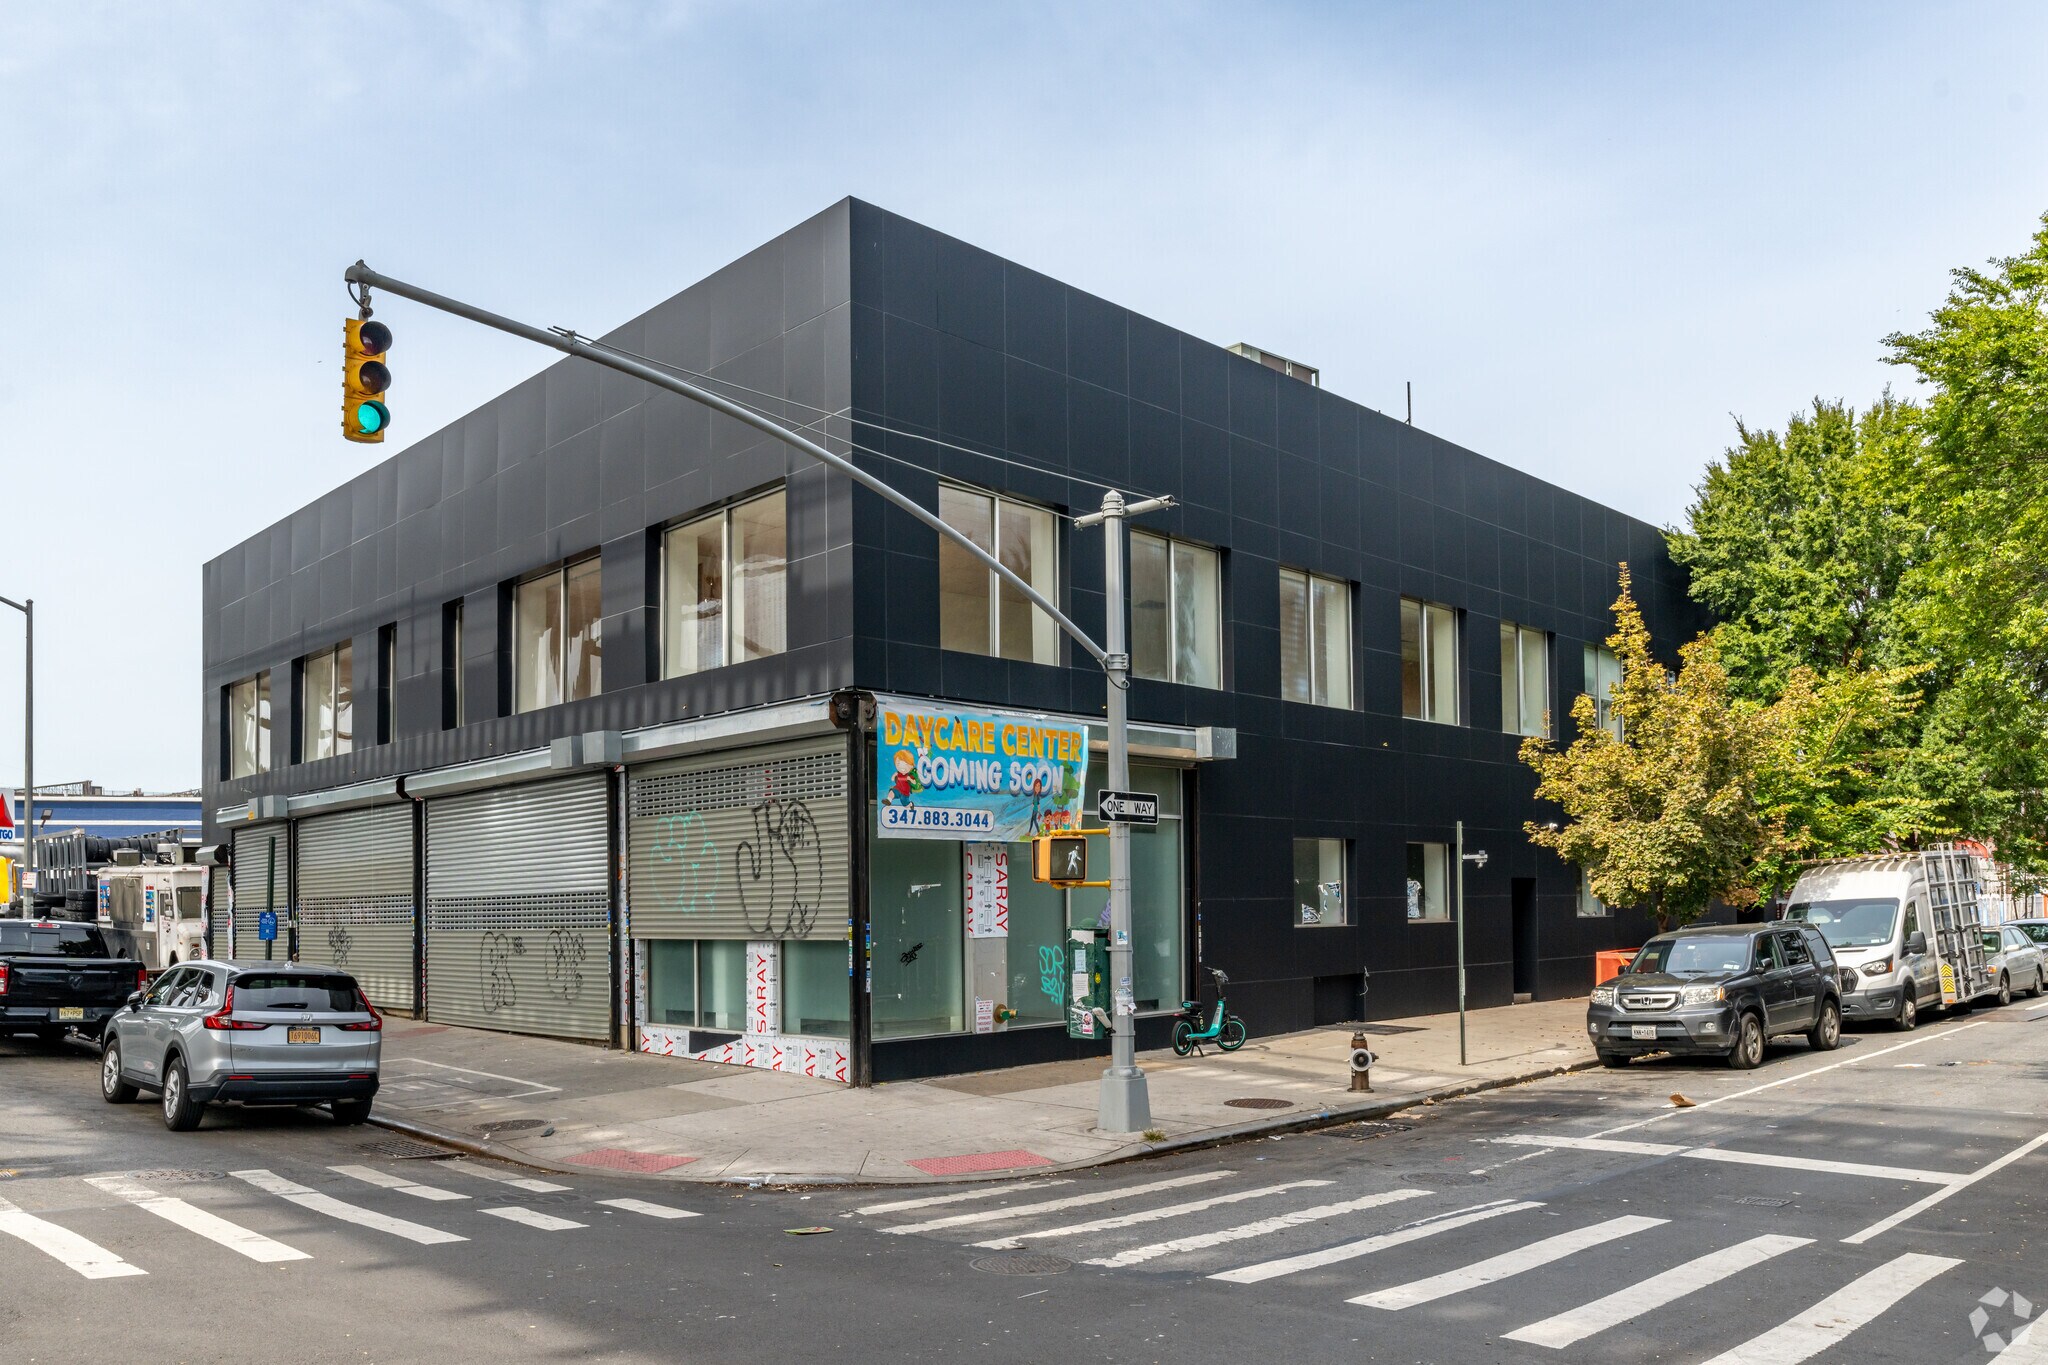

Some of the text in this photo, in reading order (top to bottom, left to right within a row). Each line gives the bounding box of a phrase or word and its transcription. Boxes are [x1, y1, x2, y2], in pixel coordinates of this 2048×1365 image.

[884, 711, 1082, 762] DAYCARE CENTER
[917, 755, 1065, 797] COMING SOON
[888, 808, 989, 828] 347.883.3044
[1107, 800, 1153, 815] ONE WAY
[995, 852, 1008, 931] SARAY
[756, 953, 767, 1033] SARAY
